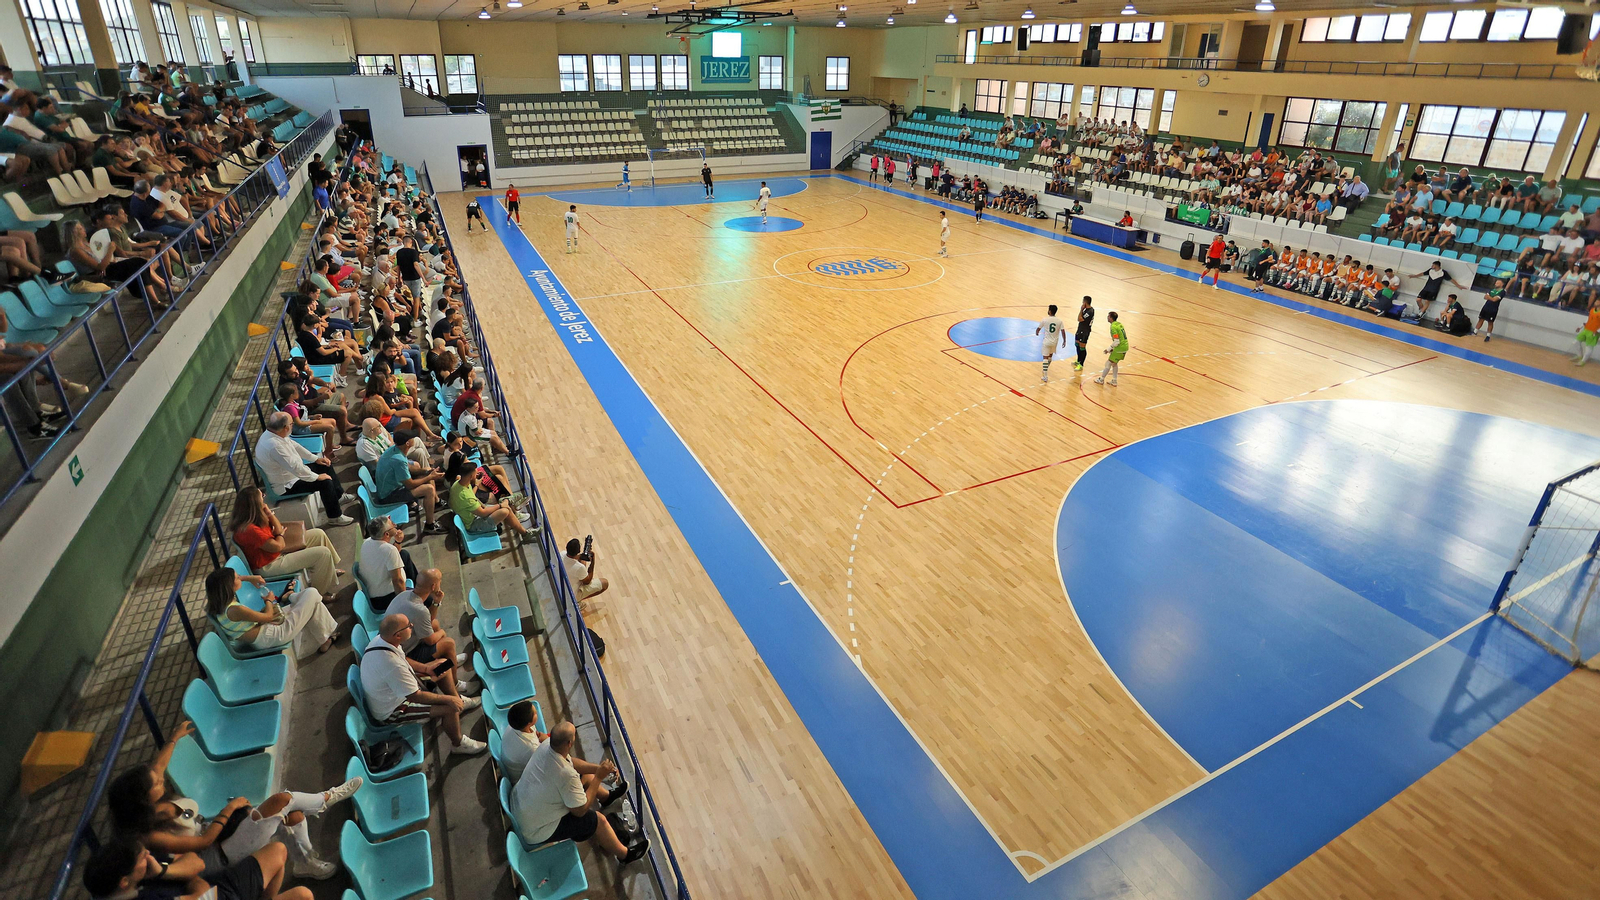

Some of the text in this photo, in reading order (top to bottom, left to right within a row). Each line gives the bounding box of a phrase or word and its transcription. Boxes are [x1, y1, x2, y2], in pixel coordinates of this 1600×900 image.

[702, 61, 749, 80] JEREZ
[527, 270, 594, 344] Ayuntamiento de Jerez
[1049, 322, 1057, 333] 6
